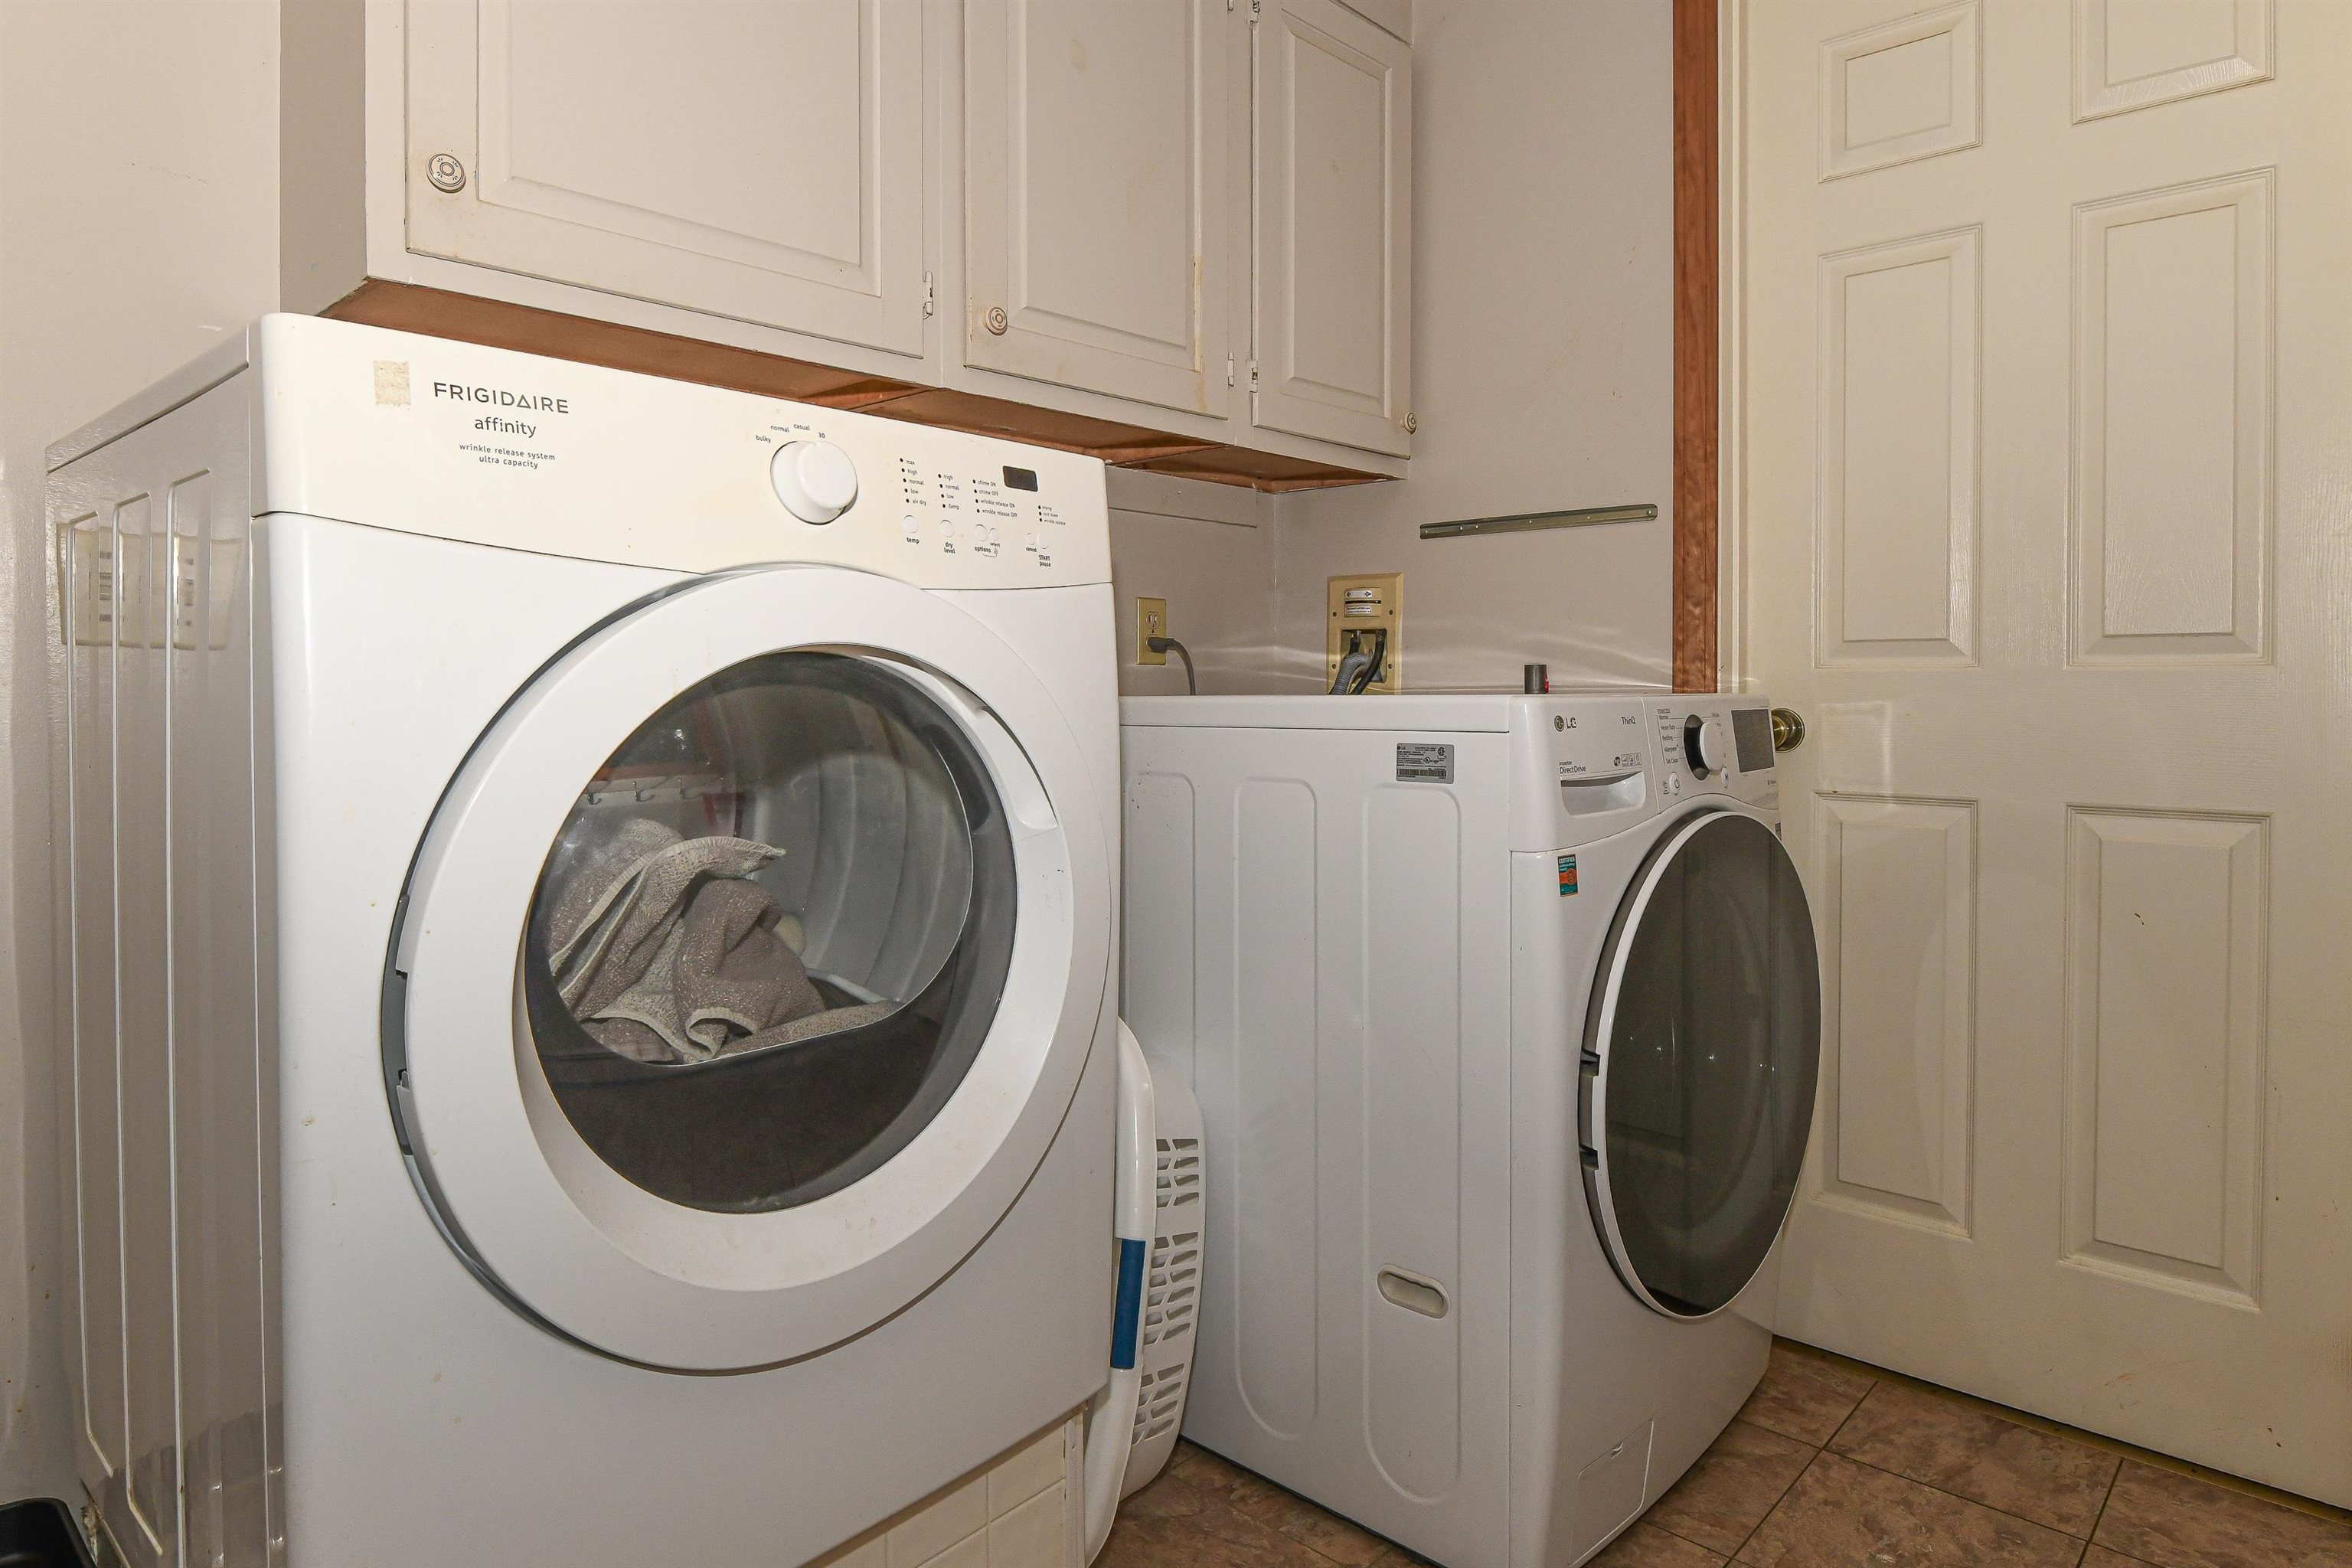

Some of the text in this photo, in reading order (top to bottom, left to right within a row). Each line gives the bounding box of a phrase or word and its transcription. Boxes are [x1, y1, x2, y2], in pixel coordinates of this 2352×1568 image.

[433, 381, 569, 414] FRIGIDAIRE
[474, 416, 537, 439] affinity
[756, 434, 771, 443] bulky
[459, 443, 555, 461] wrinkle release system
[479, 456, 538, 469] ultra capacity
[1565, 717, 1577, 729] LG
[1621, 716, 1635, 725] ThinQ
